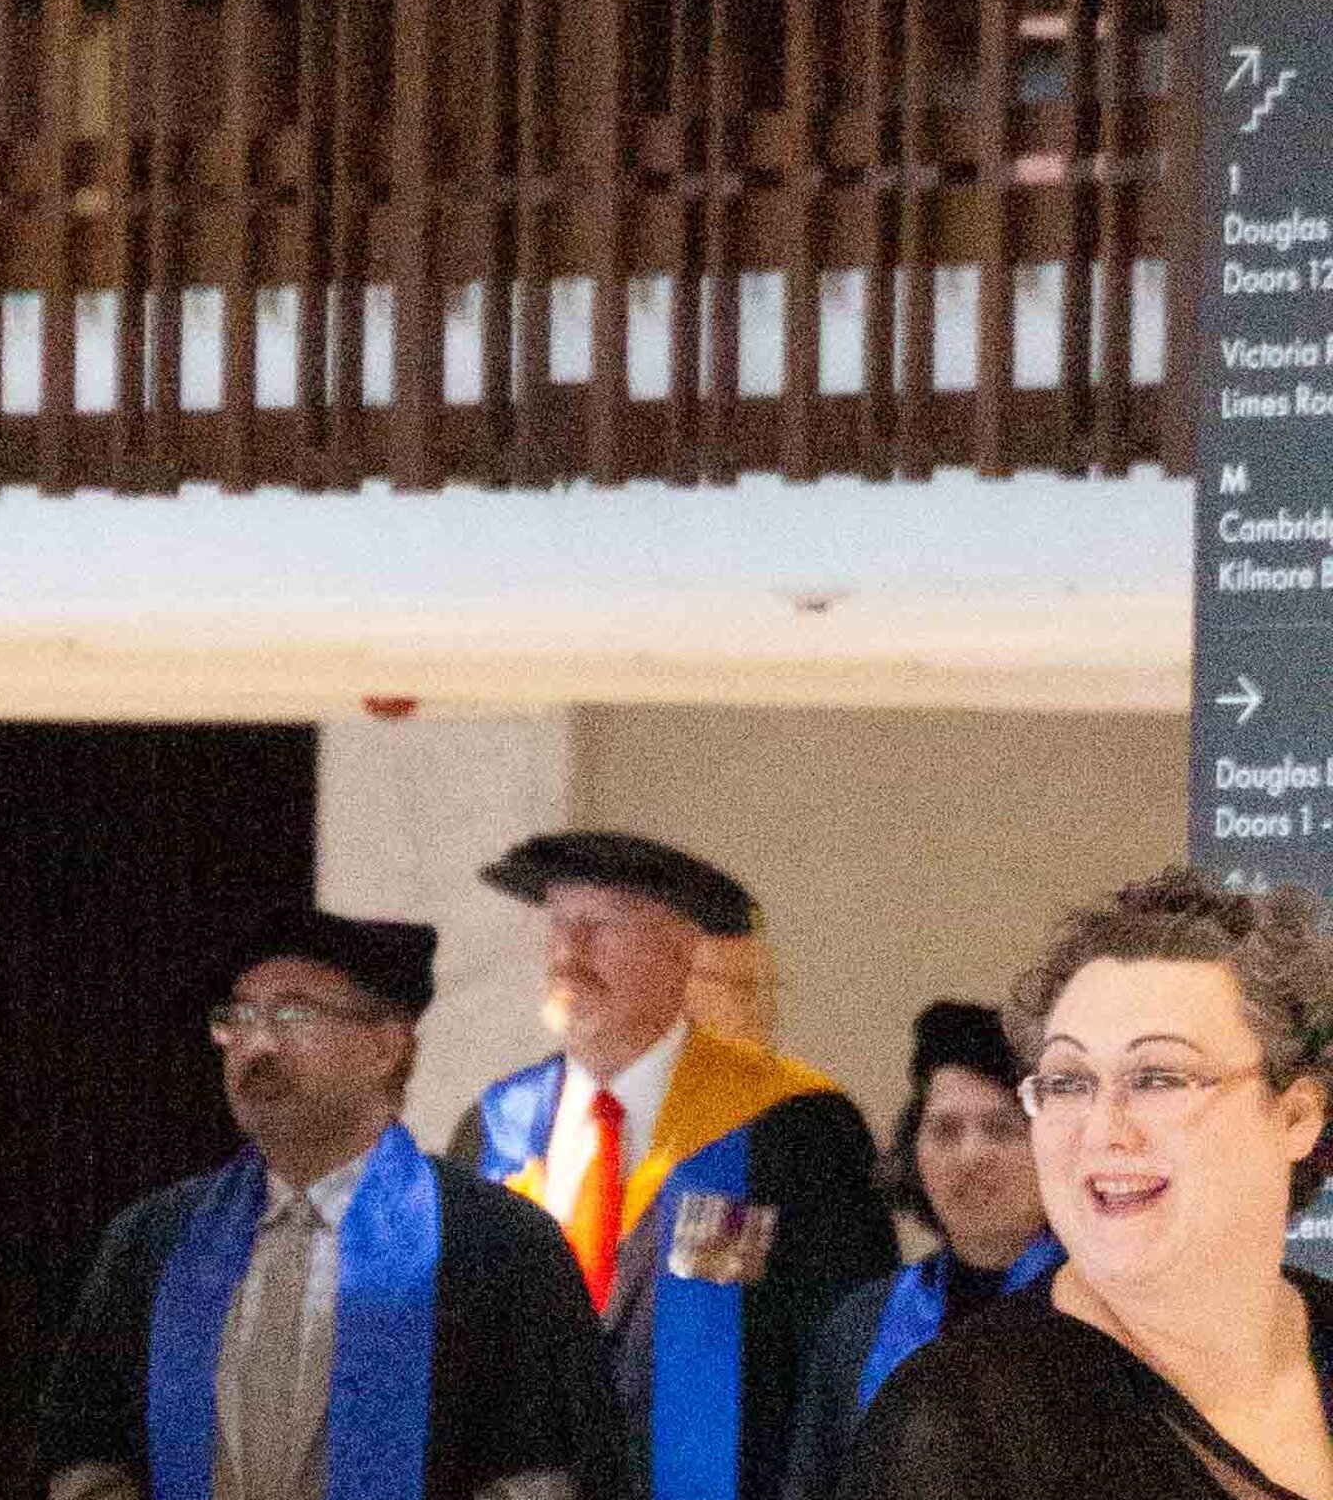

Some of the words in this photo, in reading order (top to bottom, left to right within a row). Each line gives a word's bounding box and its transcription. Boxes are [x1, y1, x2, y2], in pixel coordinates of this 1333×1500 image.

[1223, 209, 1327, 251] Douglas
[1223, 262, 1297, 293] Doors
[1221, 338, 1317, 368] Victoria
[1221, 386, 1288, 418] Limes
[1221, 464, 1247, 492] M
[1219, 557, 1314, 591] Kilmore
[1216, 756, 1321, 796] Douglas
[1216, 807, 1290, 837] Doors
[1300, 804, 1312, 835] 1
